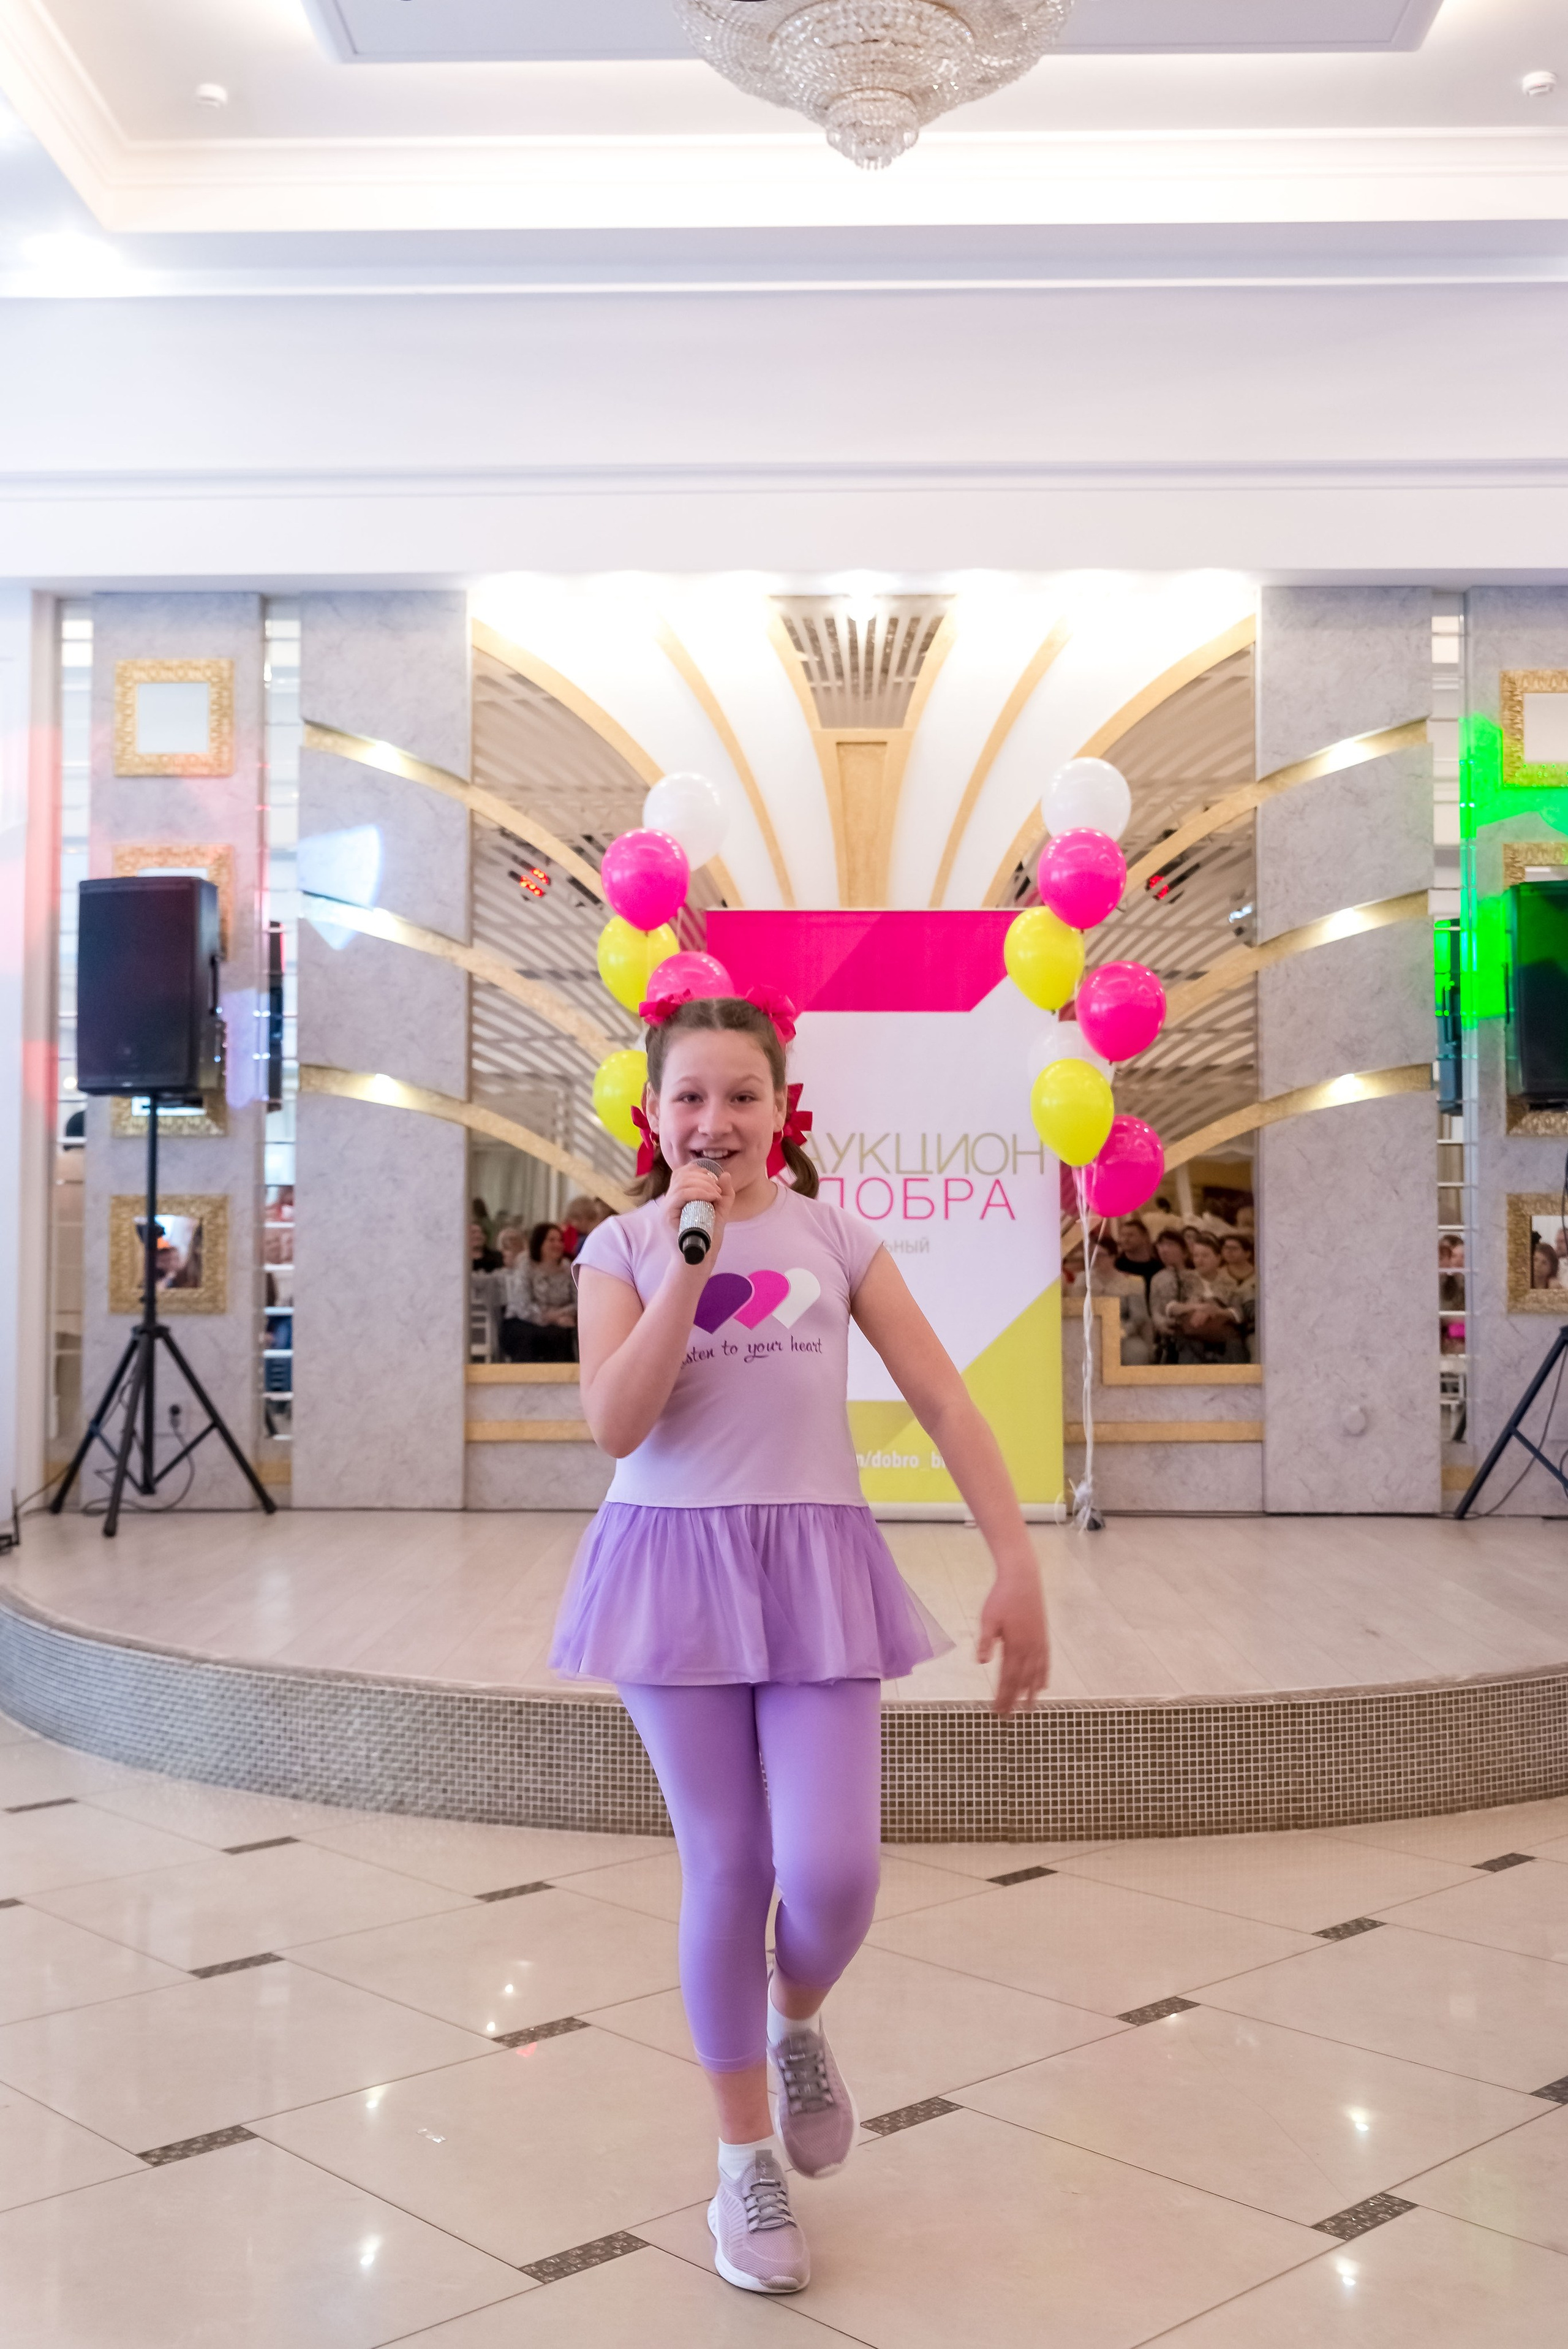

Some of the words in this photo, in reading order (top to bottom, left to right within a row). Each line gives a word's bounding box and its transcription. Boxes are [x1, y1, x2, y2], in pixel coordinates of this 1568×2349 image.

[803, 1132, 1044, 1174] АУКЦИОН
[680, 1347, 715, 1369] sten
[722, 1339, 738, 1356] to
[744, 1341, 783, 1363] your
[791, 1335, 823, 1353] heart
